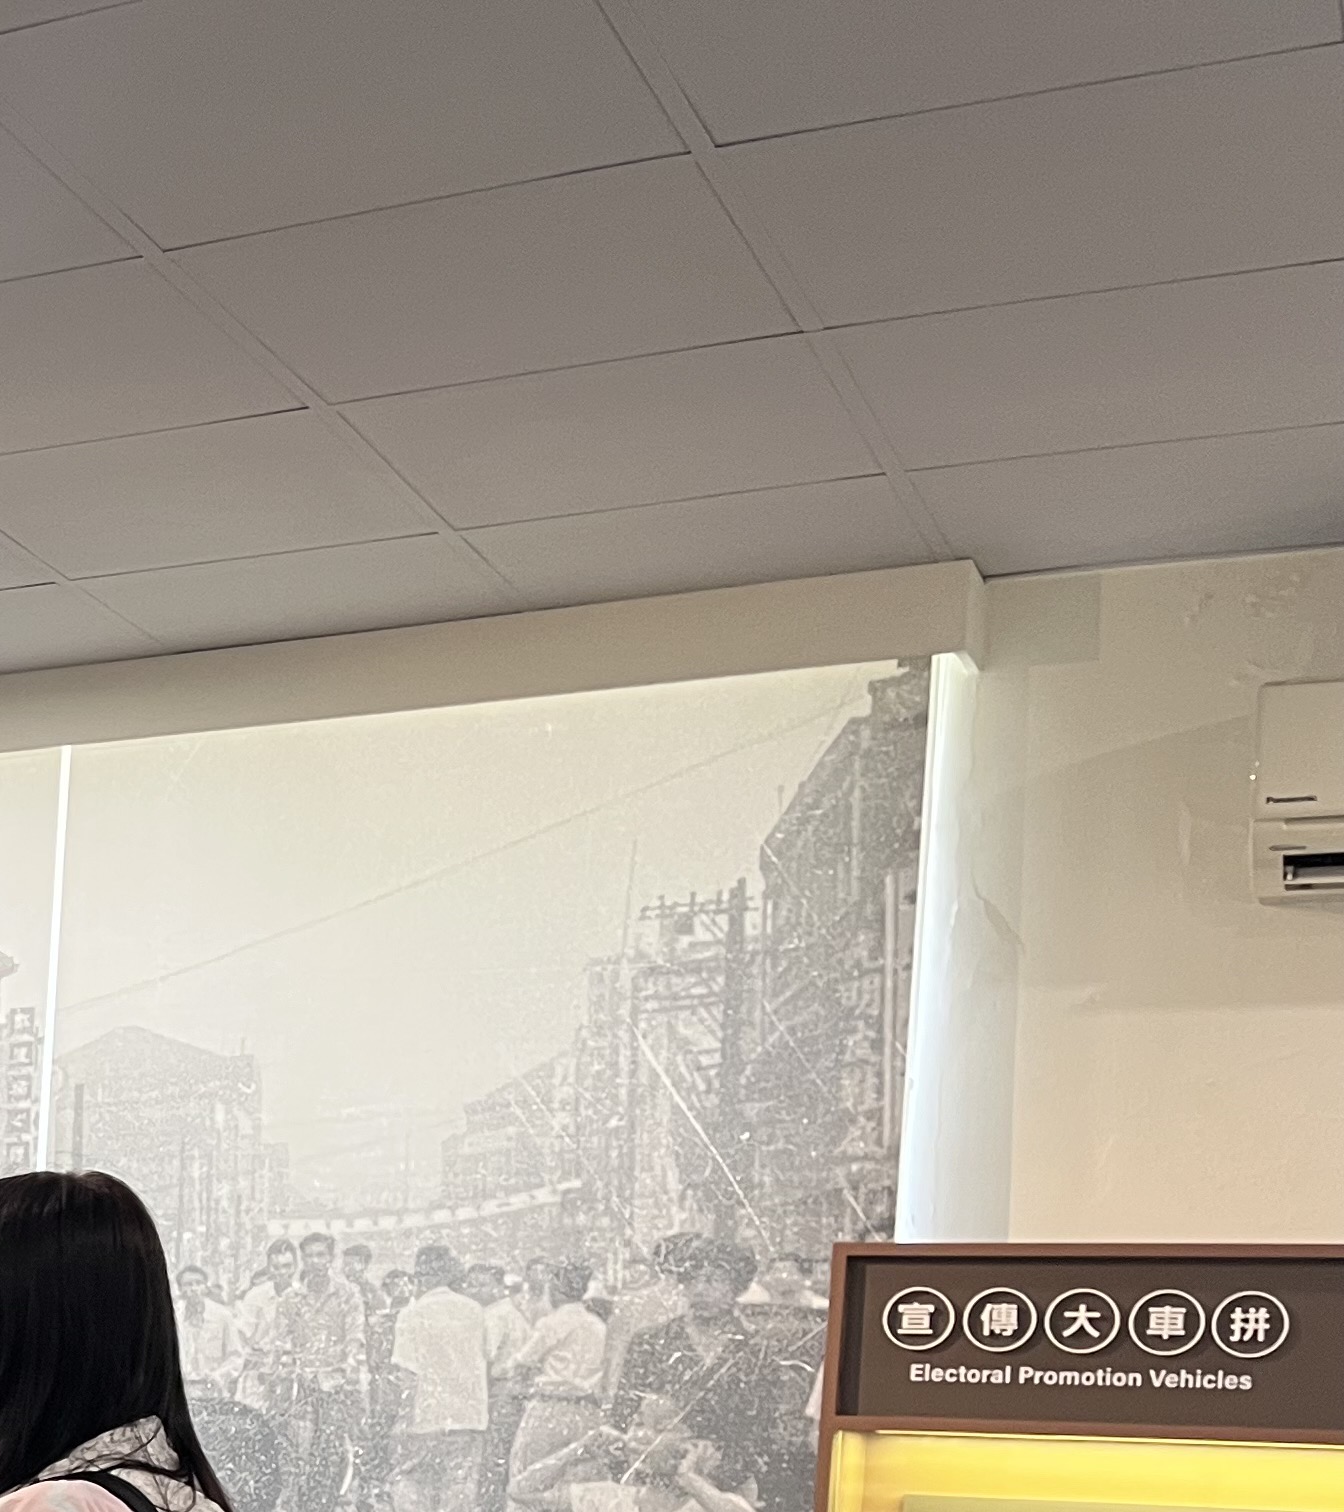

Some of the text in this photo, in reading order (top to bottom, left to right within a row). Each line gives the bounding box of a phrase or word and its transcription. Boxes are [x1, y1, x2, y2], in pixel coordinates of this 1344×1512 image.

[894, 1299, 1274, 1345] 宣傳大車拼
[909, 1362, 1253, 1391] Electoral Promotion Vehicles
